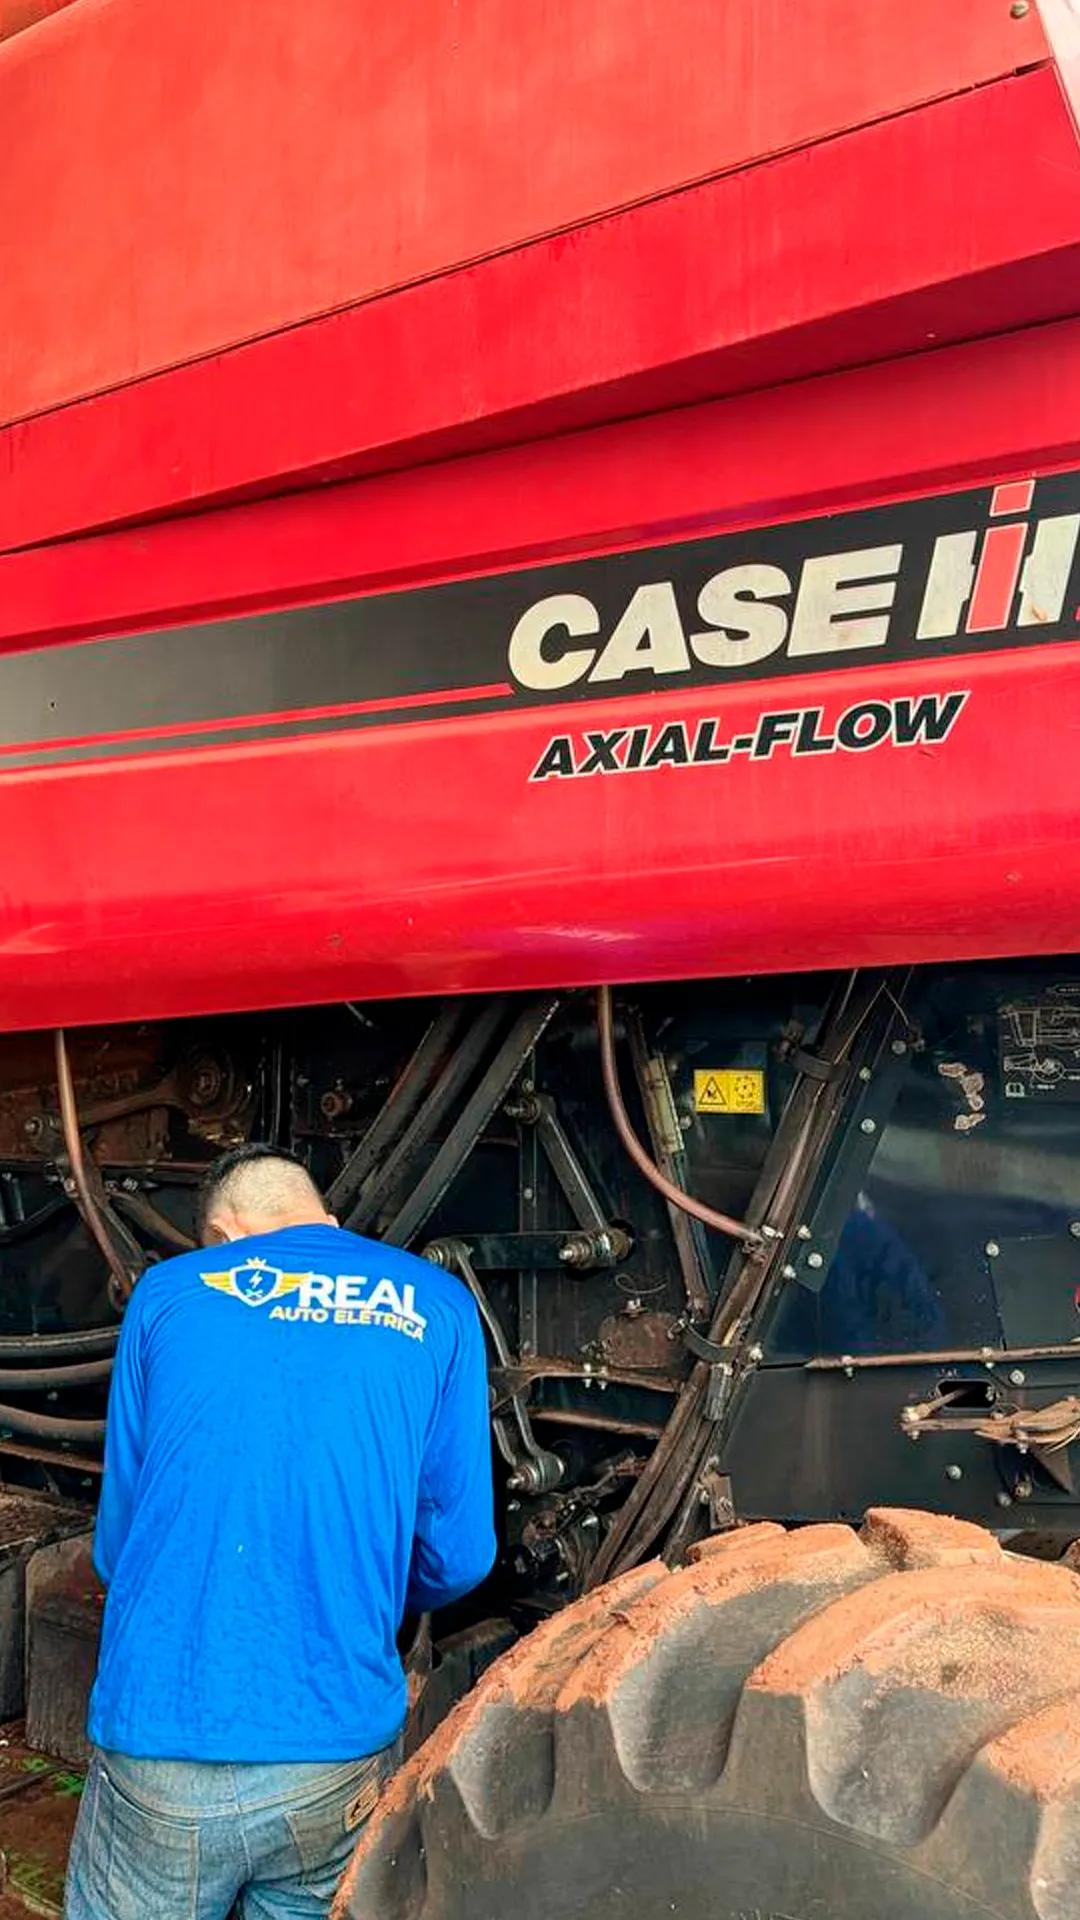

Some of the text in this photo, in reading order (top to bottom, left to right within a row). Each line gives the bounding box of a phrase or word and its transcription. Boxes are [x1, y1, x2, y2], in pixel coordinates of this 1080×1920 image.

[508, 543, 903, 690] CASE
[528, 690, 971, 782] AXIAL-FLOW
[268, 1305, 329, 1323] AUTO
[299, 1273, 427, 1328] REAL
